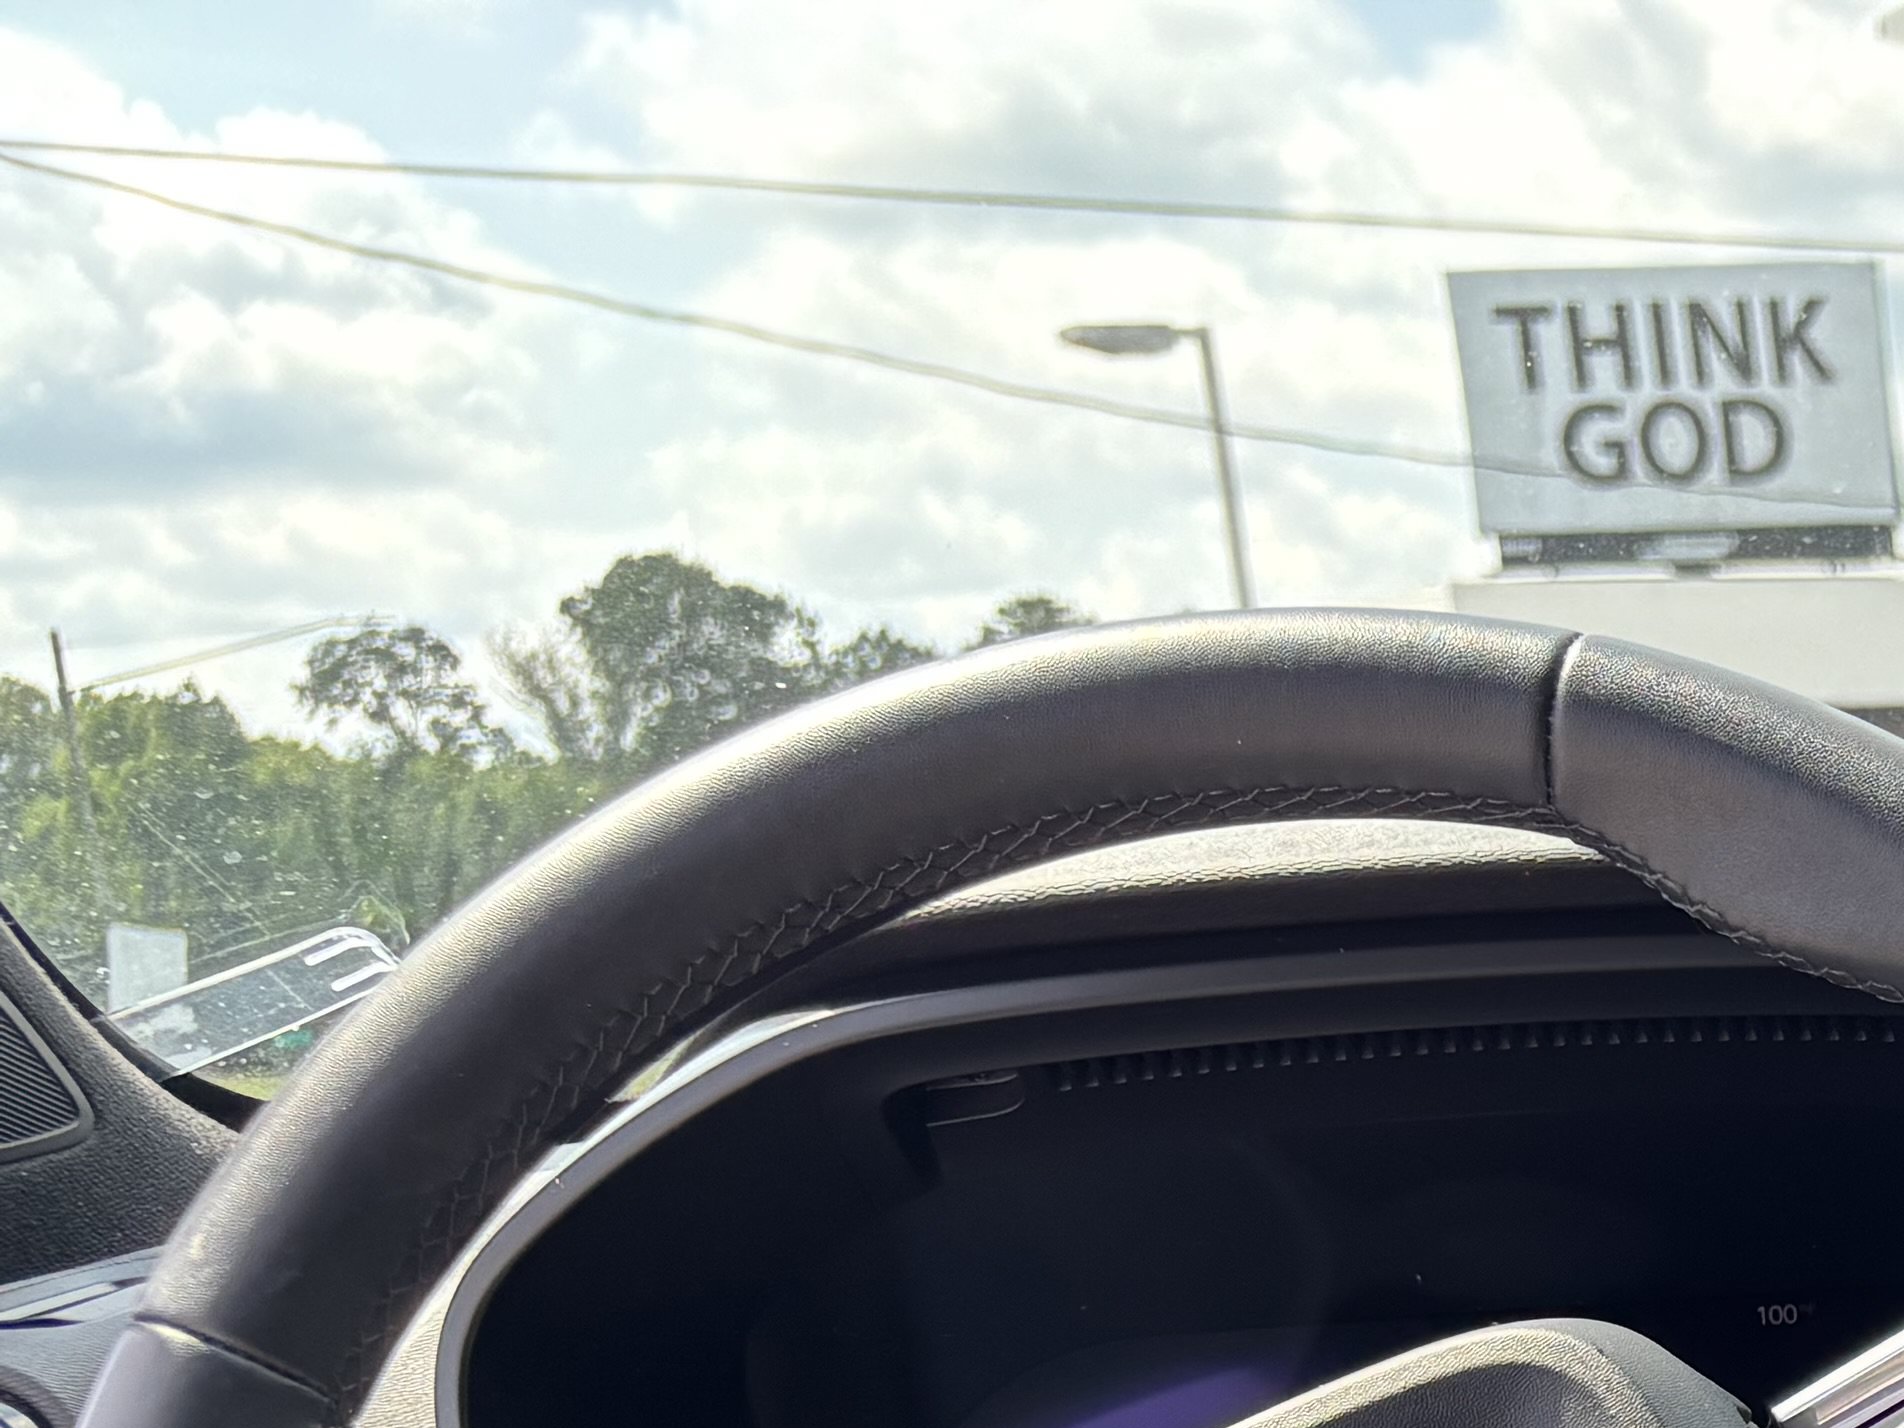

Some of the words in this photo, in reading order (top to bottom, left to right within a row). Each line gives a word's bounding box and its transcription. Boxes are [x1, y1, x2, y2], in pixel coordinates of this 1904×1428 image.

[1494, 298, 1835, 392] THINK
[1562, 400, 1787, 486] GOD
[1757, 1303, 1798, 1326] 100
